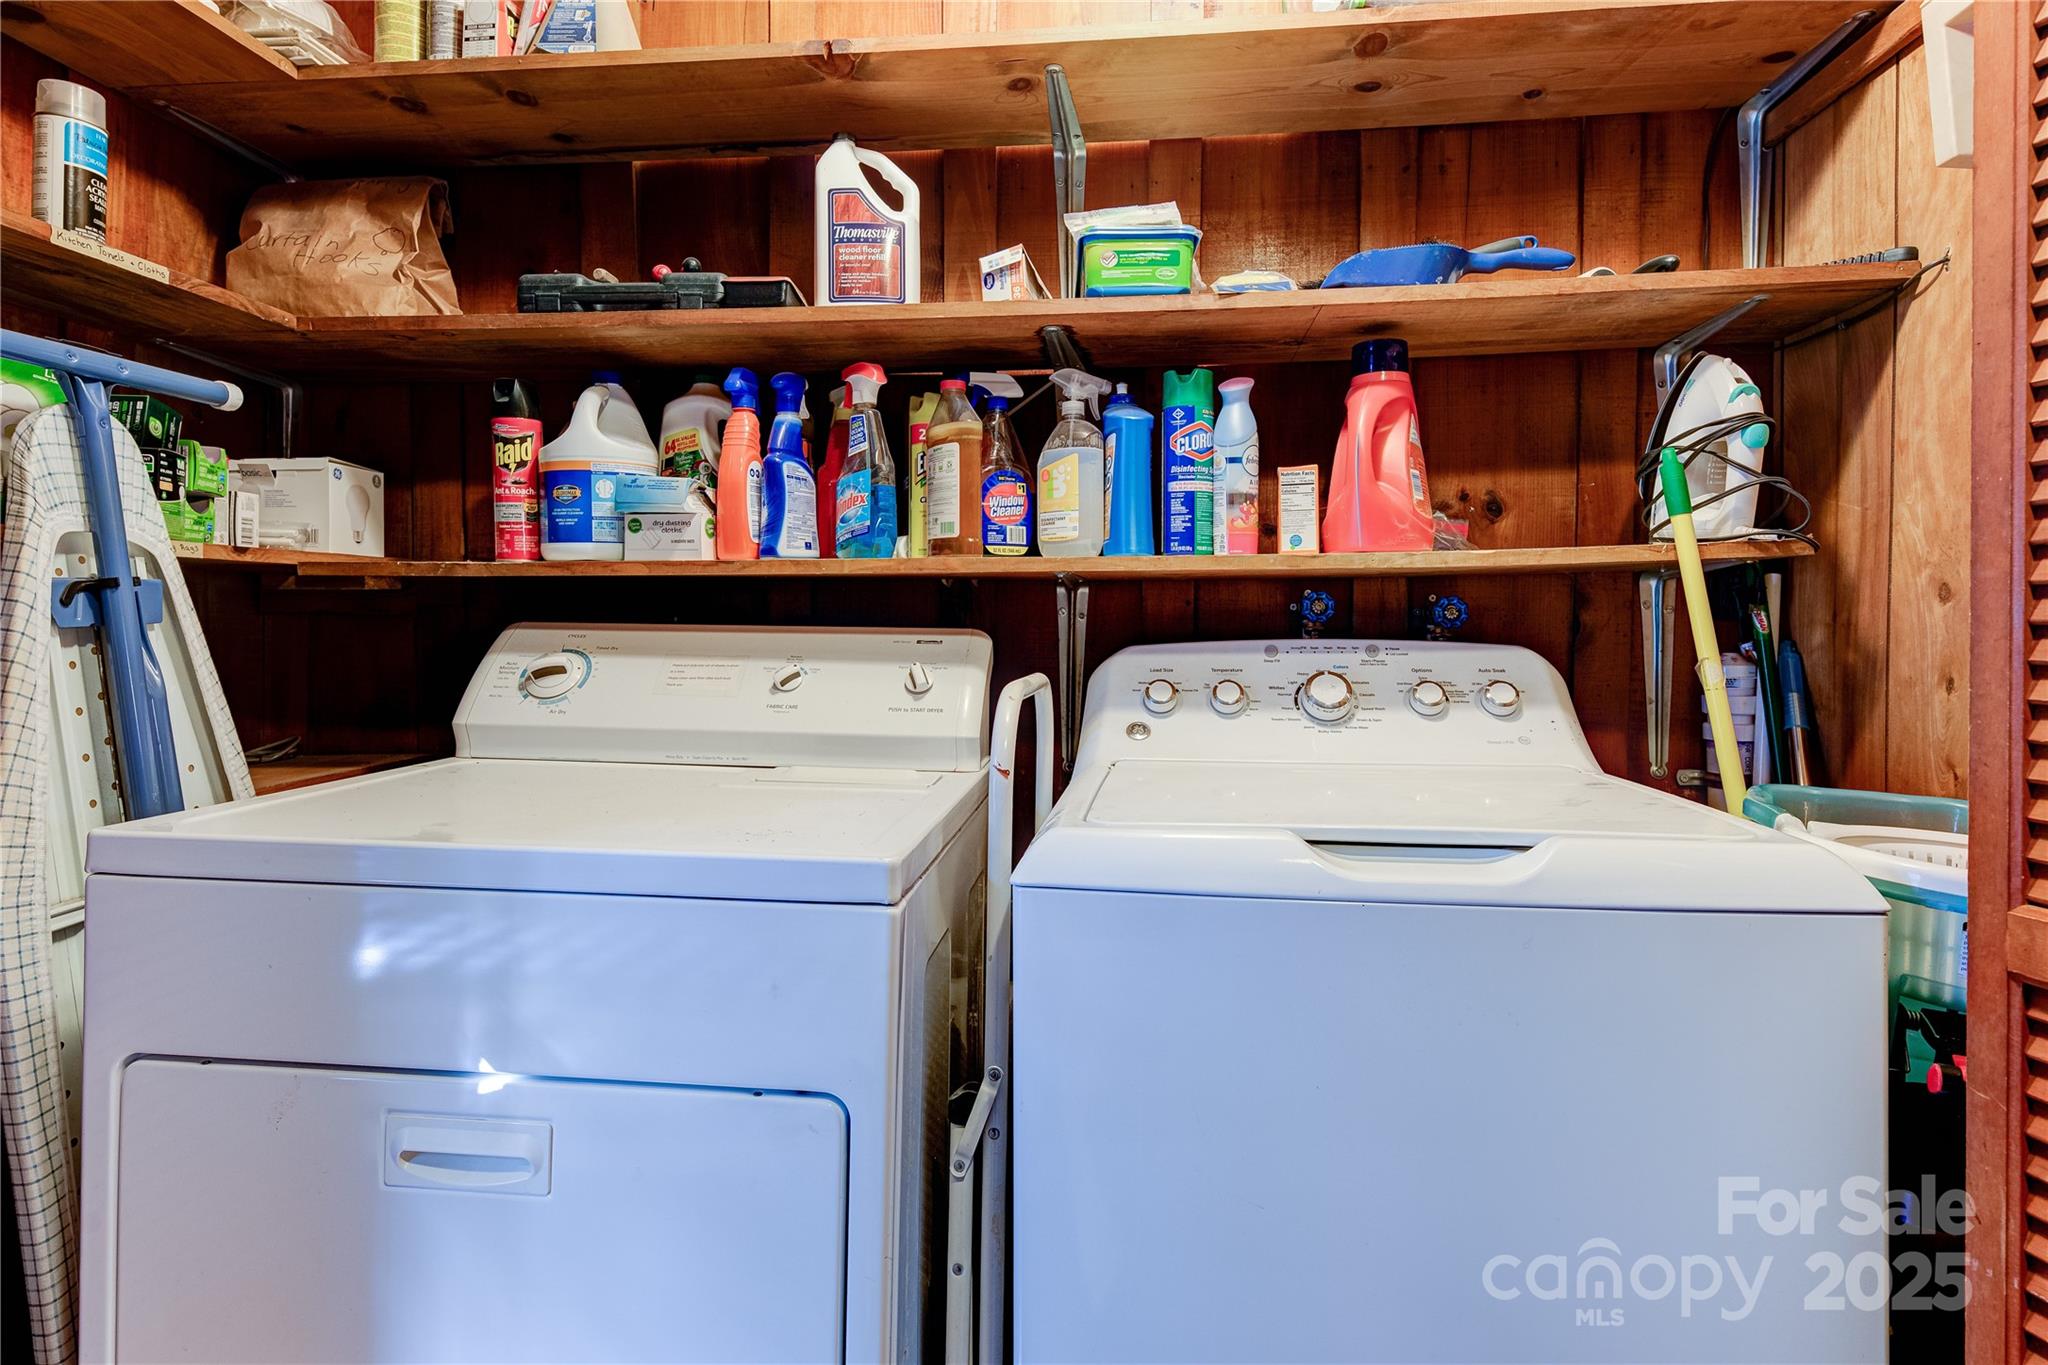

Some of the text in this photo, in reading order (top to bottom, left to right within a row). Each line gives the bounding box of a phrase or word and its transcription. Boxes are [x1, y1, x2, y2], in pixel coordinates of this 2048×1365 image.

[834, 226, 900, 240] Thomasville
[56, 231, 92, 250] Kitchen
[97, 244, 124, 262] Towels
[138, 262, 166, 279] Cloths
[293, 248, 382, 276] Hooks
[665, 439, 676, 455] 64
[1176, 432, 1214, 453] CLORO
[496, 437, 532, 466] Raid
[1170, 466, 1208, 474] Disinfecting
[510, 486, 534, 495] Roach
[1018, 484, 1025, 493] $1
[989, 496, 1024, 508] Window
[990, 506, 1024, 517] Cleaner
